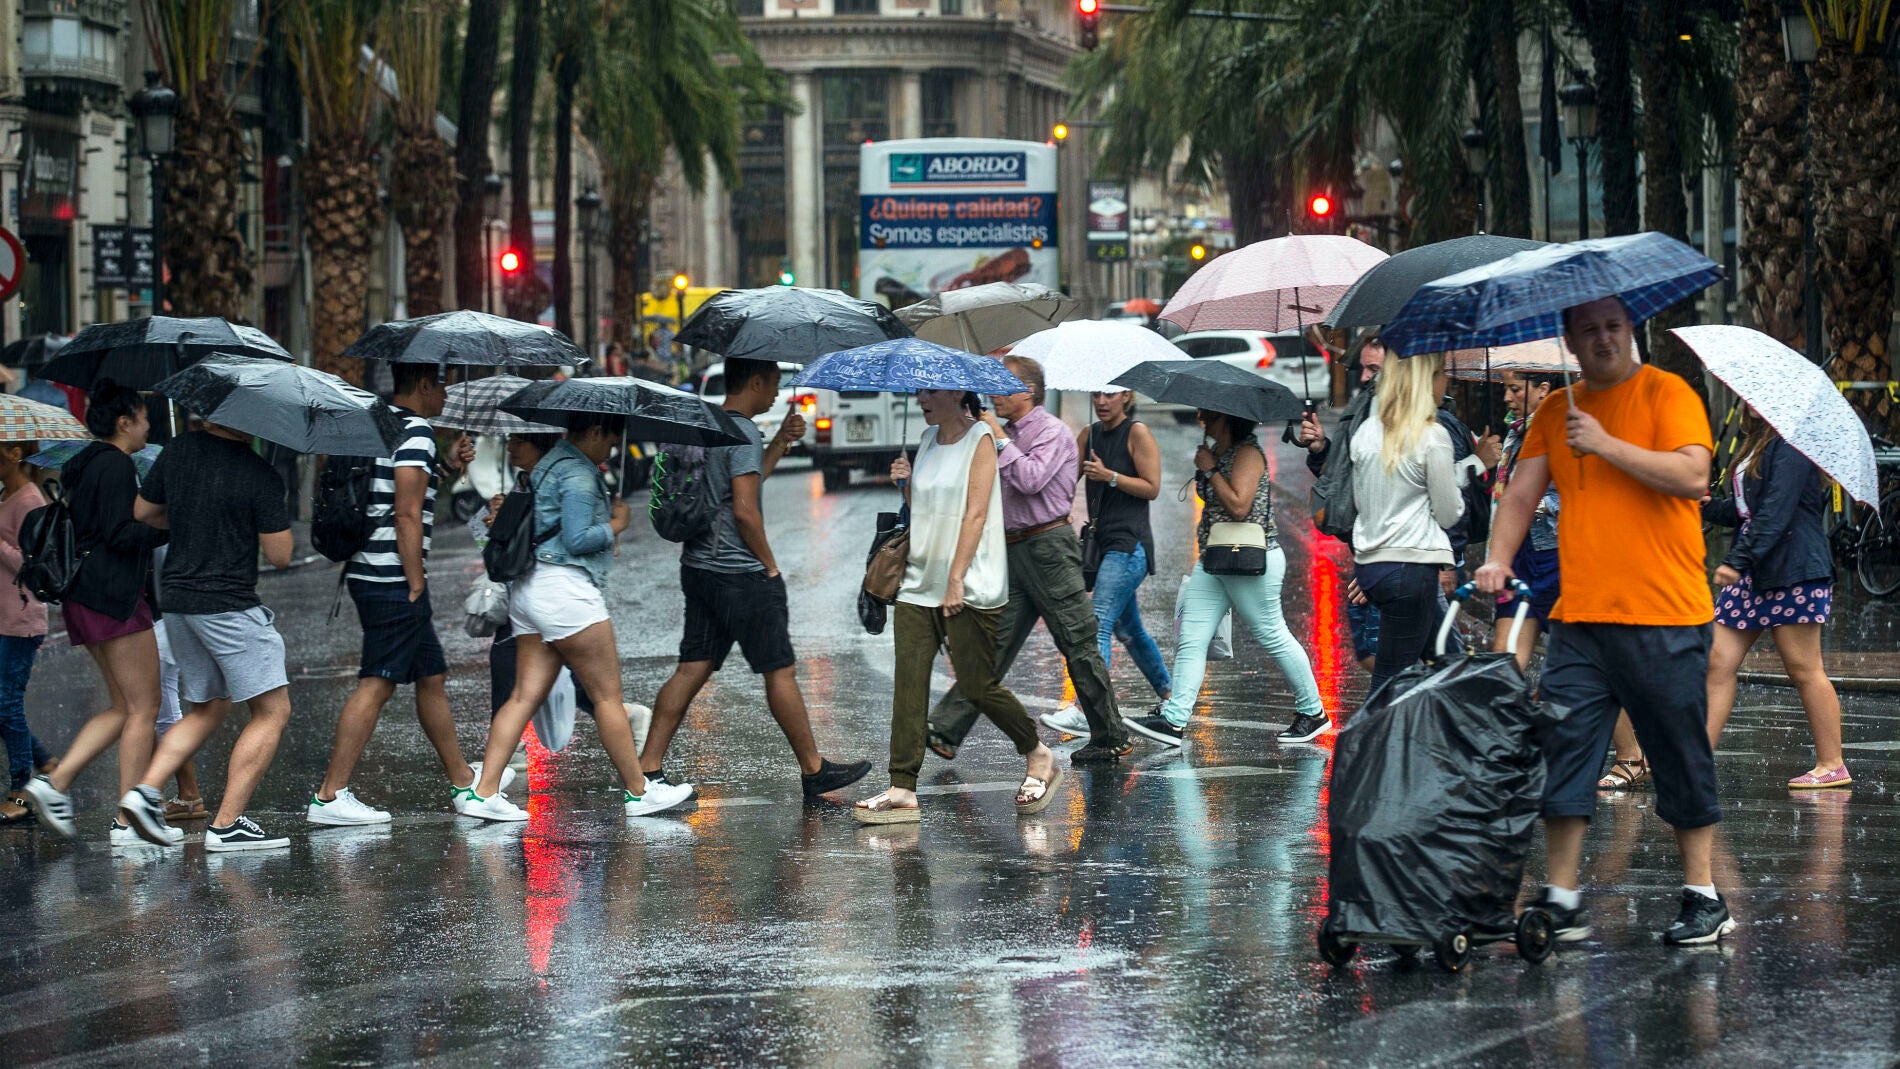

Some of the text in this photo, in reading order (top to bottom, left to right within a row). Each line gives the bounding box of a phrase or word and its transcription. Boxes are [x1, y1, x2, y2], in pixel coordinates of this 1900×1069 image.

[928, 156, 1019, 173] ABORDO
[869, 197, 1042, 220] ¿Quiere calidad?
[869, 222, 1048, 246] Somos especialistas
